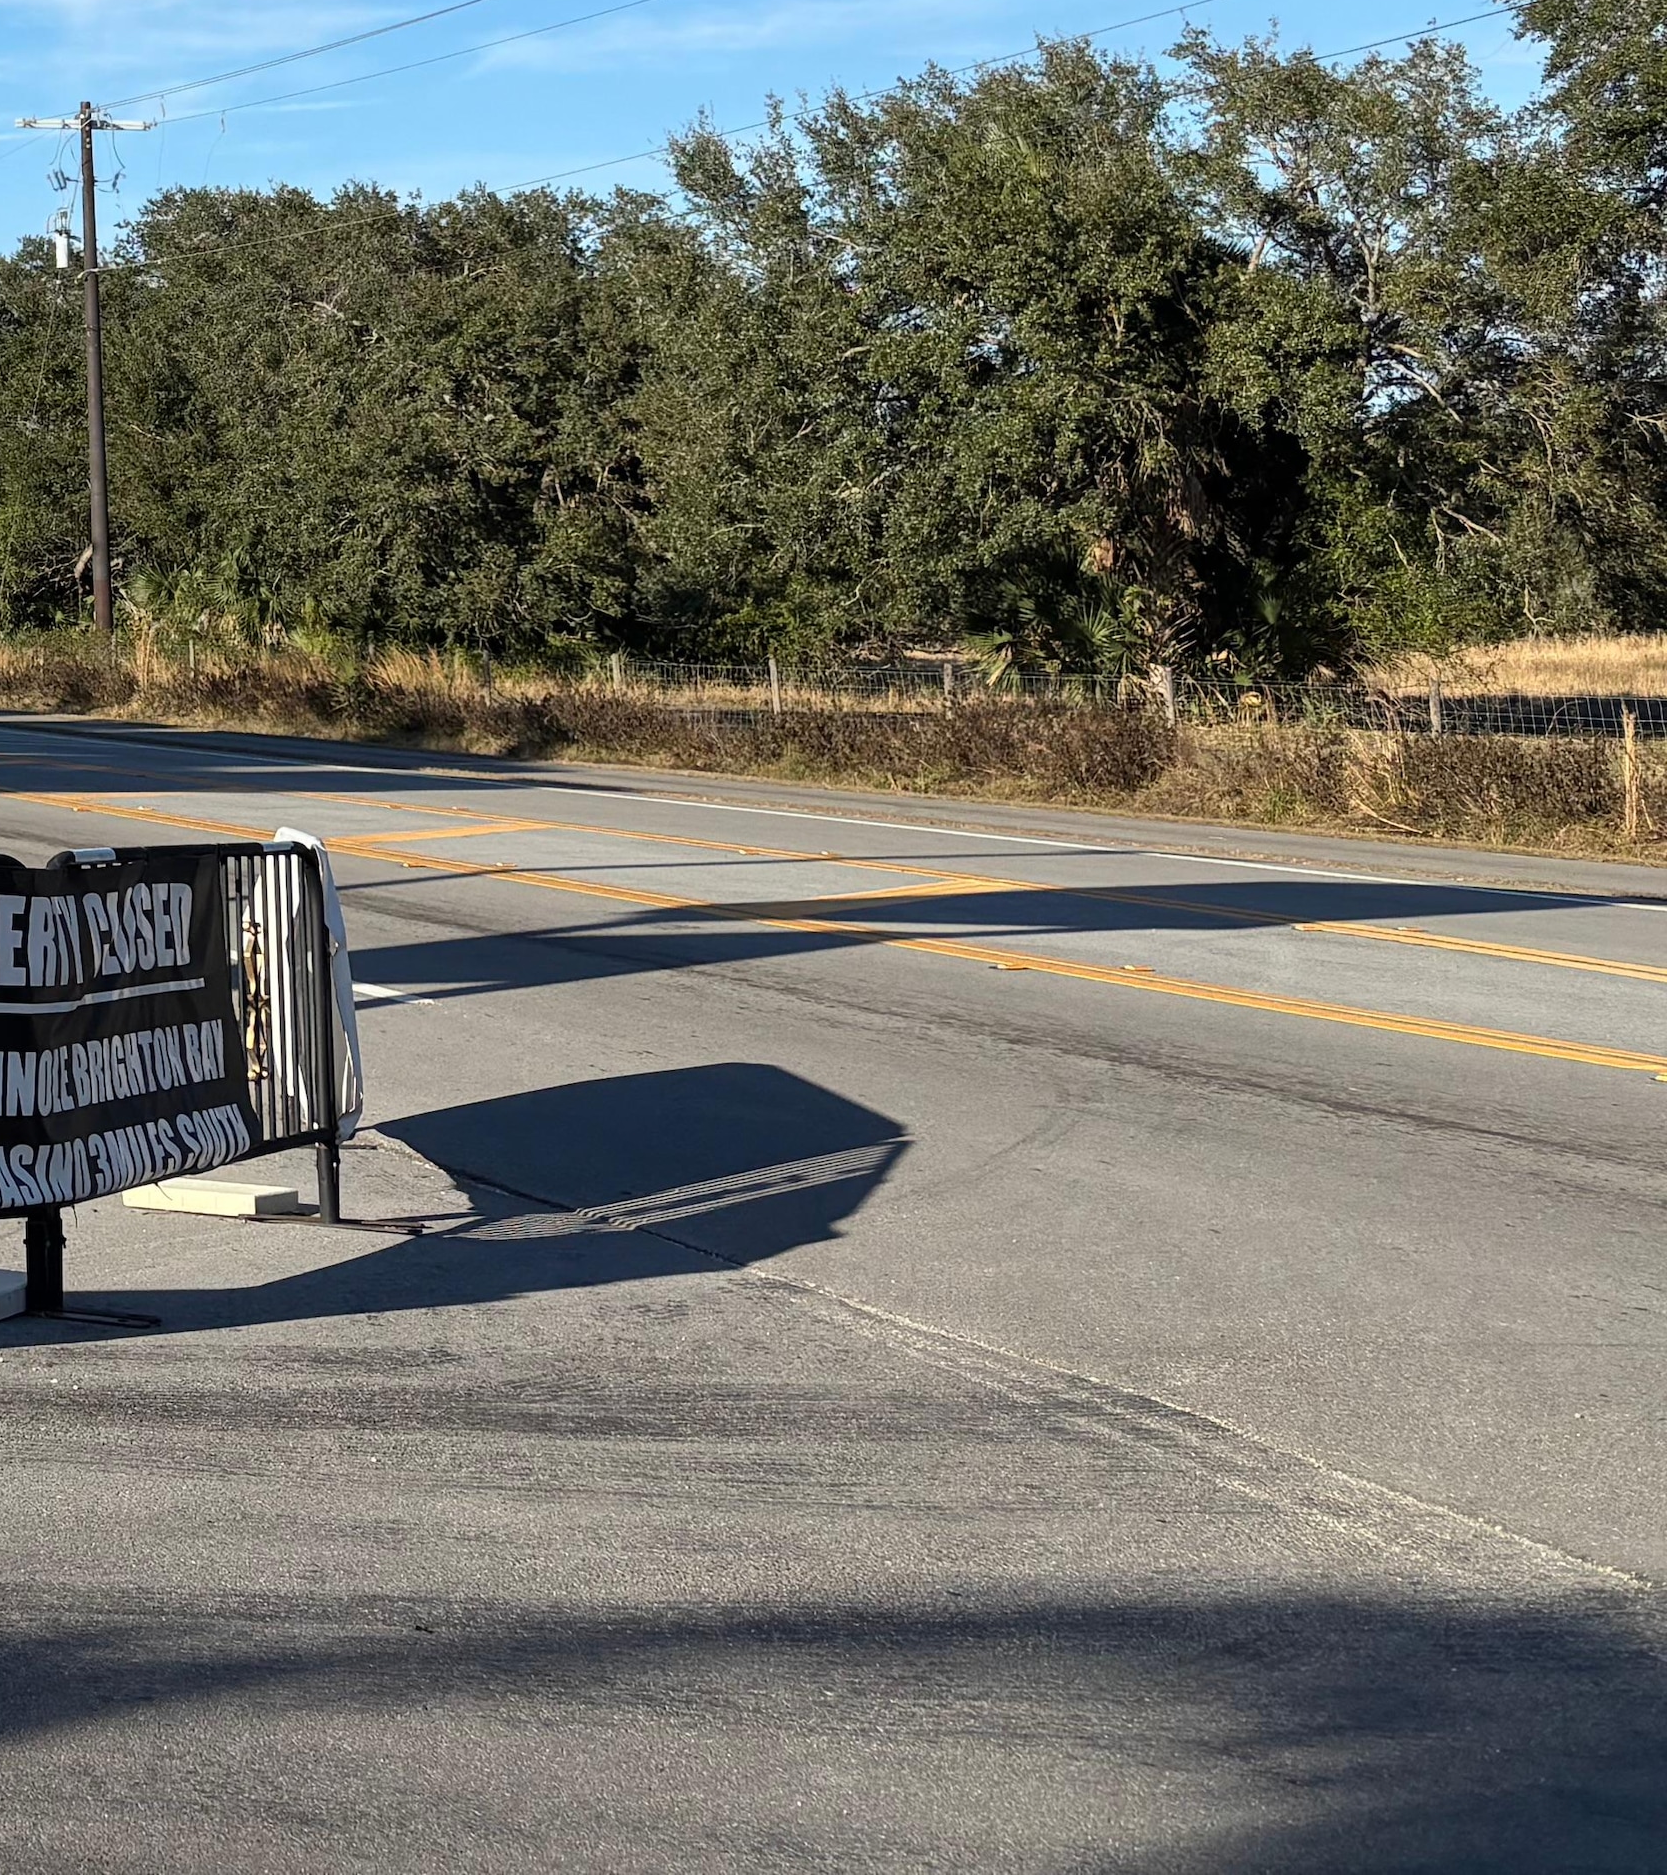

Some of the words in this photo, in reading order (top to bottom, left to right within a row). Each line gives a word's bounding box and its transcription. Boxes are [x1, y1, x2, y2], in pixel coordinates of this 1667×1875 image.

[82, 883, 192, 975] CLOSED
[71, 1026, 186, 1108] BRIGHTON
[183, 1019, 225, 1083] BAY
[177, 1104, 251, 1170] SOUTH
